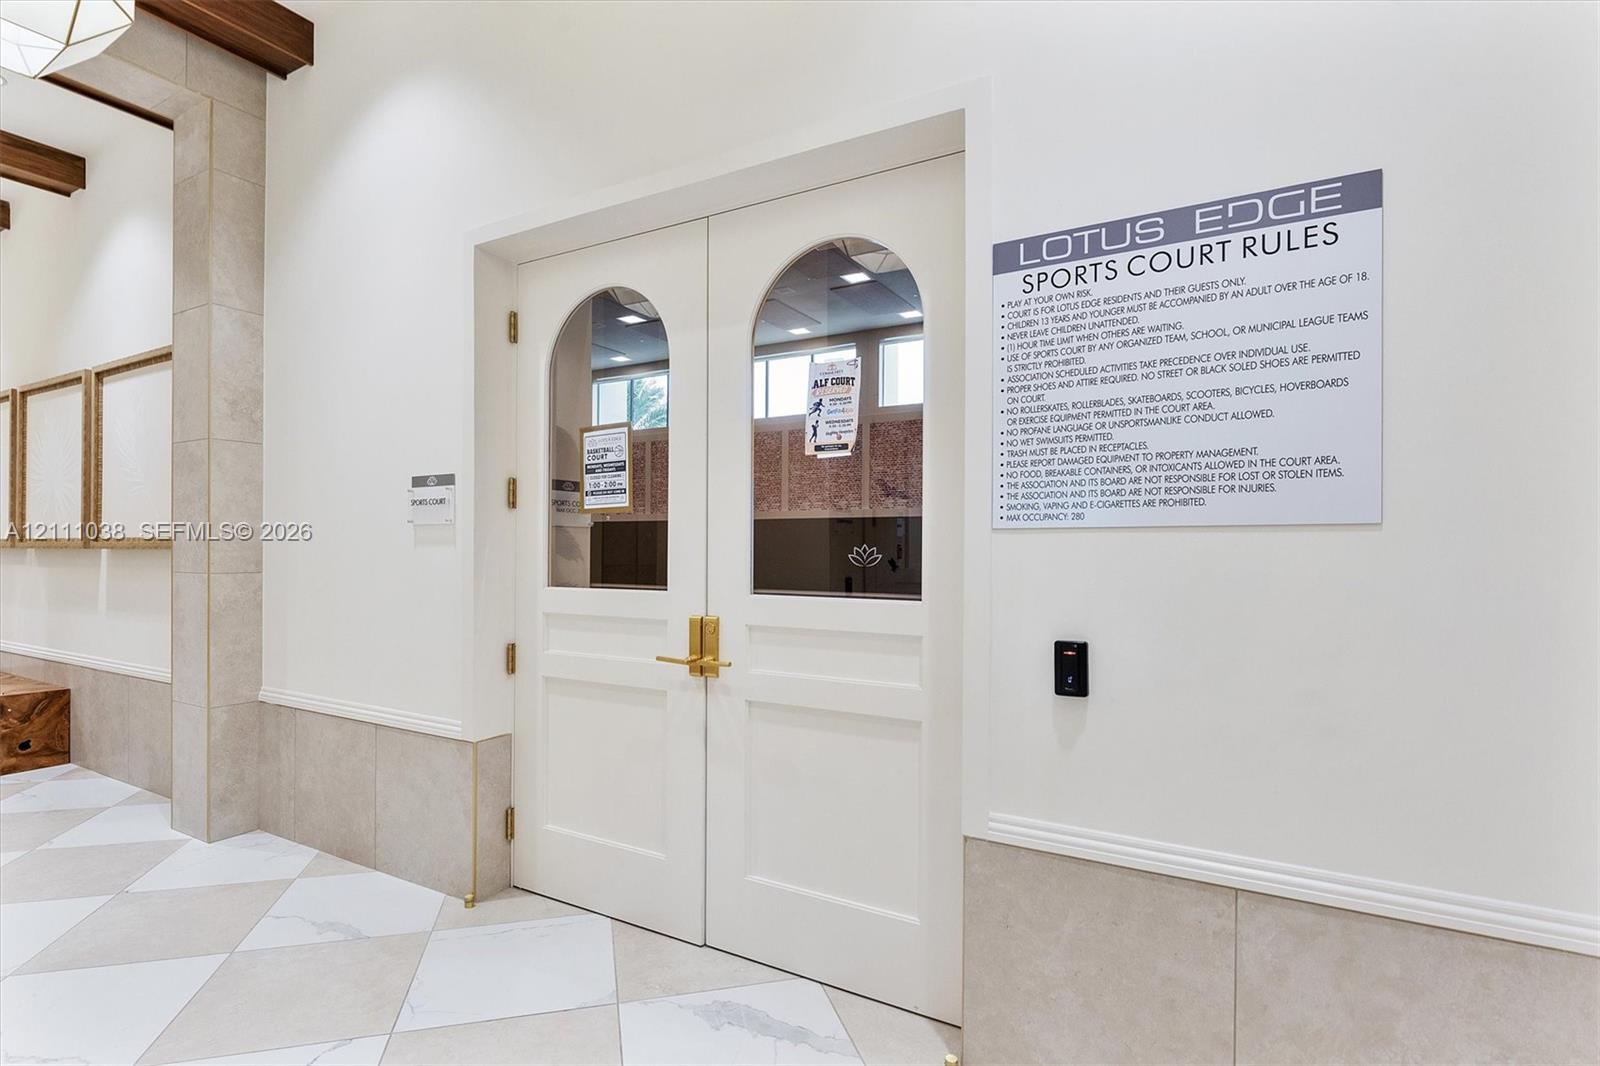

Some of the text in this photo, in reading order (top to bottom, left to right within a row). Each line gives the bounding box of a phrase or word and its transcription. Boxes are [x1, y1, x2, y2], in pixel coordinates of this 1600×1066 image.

[1019, 181, 1342, 267] LOTUS EDGE
[1021, 219, 1339, 295] SPORTS COURT RULES
[1006, 276, 1246, 319] COURT IS FOR LOTUS EDGE RESIDENTS AND THEIR GUESTS ONLY.
[1006, 288, 1092, 309] PLAY AT YOUR OWN RISK.
[1006, 271, 1369, 330] CHILDREN 13 YEARS AND YOUNGER MUST BE ACCOMPANIED BY AN ADULT OVER THE AGE OF 18.
[1006, 315, 1139, 341] NEVER LEAVE CHILDREN UNATTENDED.
[1006, 310, 1368, 362] USE OF SPORTS COURT BY ANY ORGANIZED TEAM, SCHOOL, OR MUNICIPAL LEAGUE TEAMS
[1006, 321, 1184, 352] (1) HOUR TIME LIMIT WHEN OTHERS ARE WAITING.
[1006, 355, 1086, 373] IS STRICTLY PROHIBITED.
[1006, 350, 1360, 394] PROPER SHOES AND ATTIRE REQUIRED. NO STREET OR BLACK SOLED SHOES ARE PERMITTED
[830, 376, 856, 386] COURT
[1006, 377, 1349, 415] NO ROLLERSKATES, ROLLERBLADES, SKATEBOARDS, SCOOTERS, BICYCLES, HOVERBOARDS
[1006, 396, 1018, 405] ON
[586, 446, 614, 455] BASKETBALL
[587, 454, 608, 462] COURT
[1006, 441, 1148, 457] TRASH MUST BE PLACED IN RECEPTACLES.
[1005, 455, 1340, 479] NO FOOD, BREAKABLE CONTAINERS, OR INTOXICANTS ALLOWED IN THE COURT AREA.
[1006, 467, 1344, 489] THE ASSOCIATION AND ITS BOARD ARE NOT RESPONSIBLE FOR LOST OR STOLEN ITEMS.
[428, 497, 446, 506] COURT
[1005, 497, 1206, 511] SMOKING, VAPING AND E-CIGARETTES ARE PROHIBITED.
[1006, 512, 1084, 521] MAX OCCUPANCY: 280
